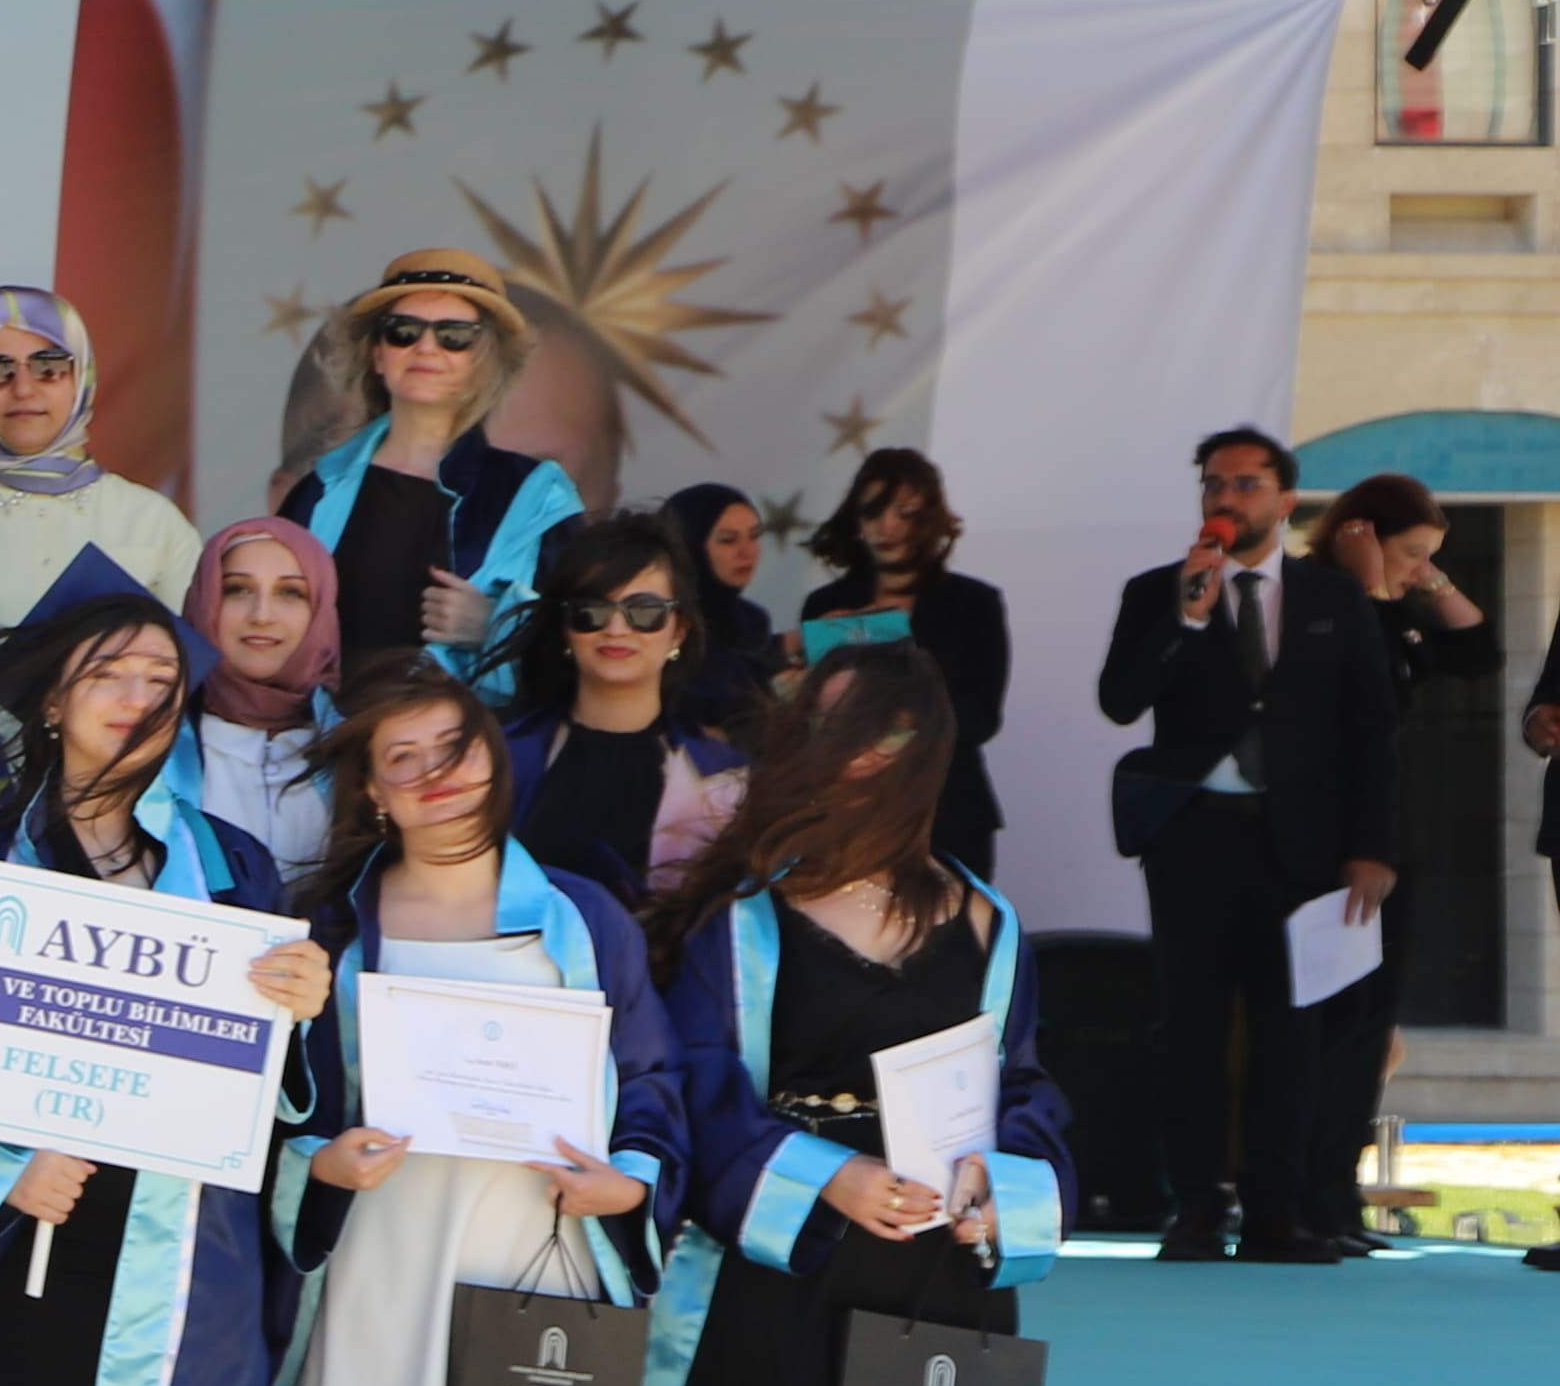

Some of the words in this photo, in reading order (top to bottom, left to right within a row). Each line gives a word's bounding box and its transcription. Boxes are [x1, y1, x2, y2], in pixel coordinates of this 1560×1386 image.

[36, 919, 218, 988] AYBÜ
[2, 975, 35, 1000] VE
[38, 981, 125, 1017] TOPLU
[127, 1000, 259, 1045] BİLİMLERİ
[17, 1006, 152, 1048] FAKÜLTESİ
[0, 1045, 152, 1098] FELSEFE
[32, 1089, 106, 1128] (TR)
